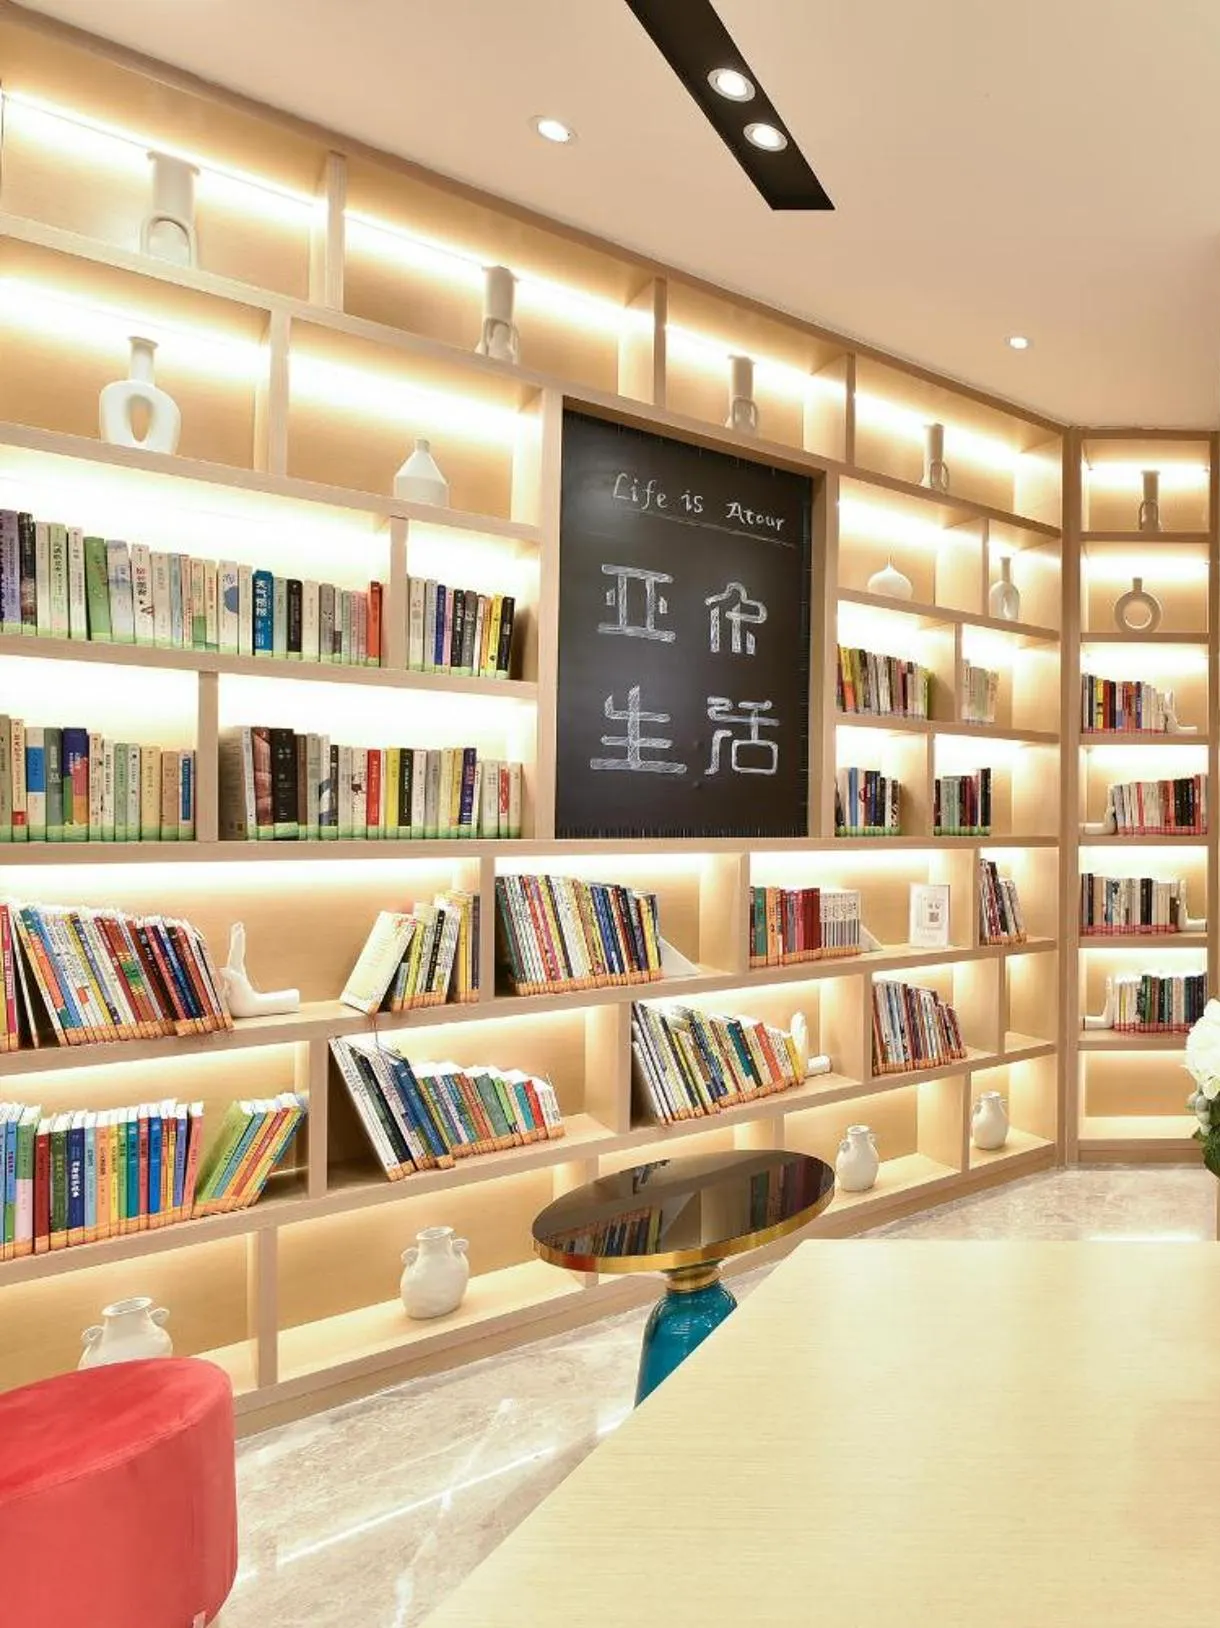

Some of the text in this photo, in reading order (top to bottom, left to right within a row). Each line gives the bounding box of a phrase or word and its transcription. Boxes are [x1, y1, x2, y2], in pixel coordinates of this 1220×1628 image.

[612, 473, 787, 531] Life is Atour
[590, 685, 780, 776] 生活
